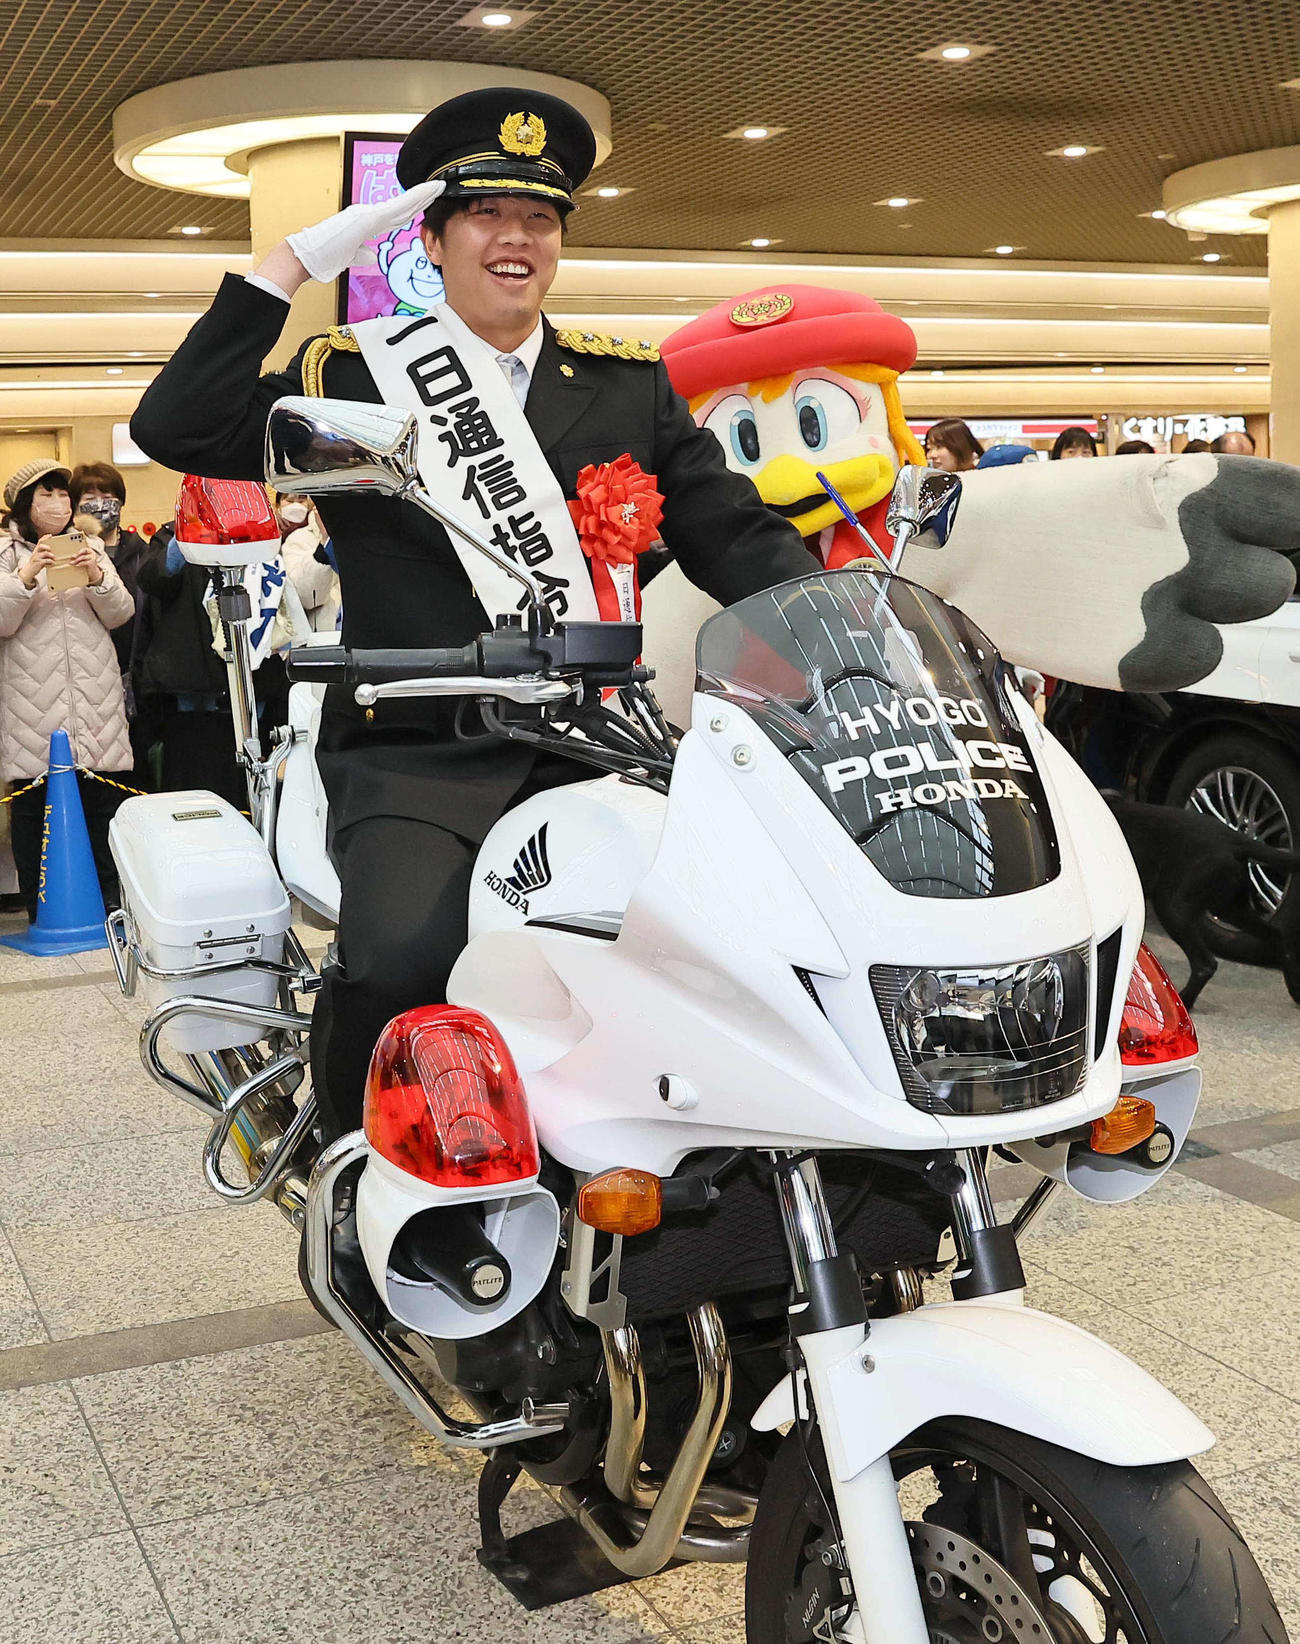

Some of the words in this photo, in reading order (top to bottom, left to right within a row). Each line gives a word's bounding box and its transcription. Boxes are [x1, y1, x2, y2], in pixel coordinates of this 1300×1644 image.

[361, 153, 398, 166] 神戸を
[841, 697, 989, 740] HYOGO
[822, 739, 1033, 792] POLICE
[874, 778, 1029, 814] HONDA
[483, 870, 530, 916] HONDA
[472, 1276, 503, 1287] PATLITE
